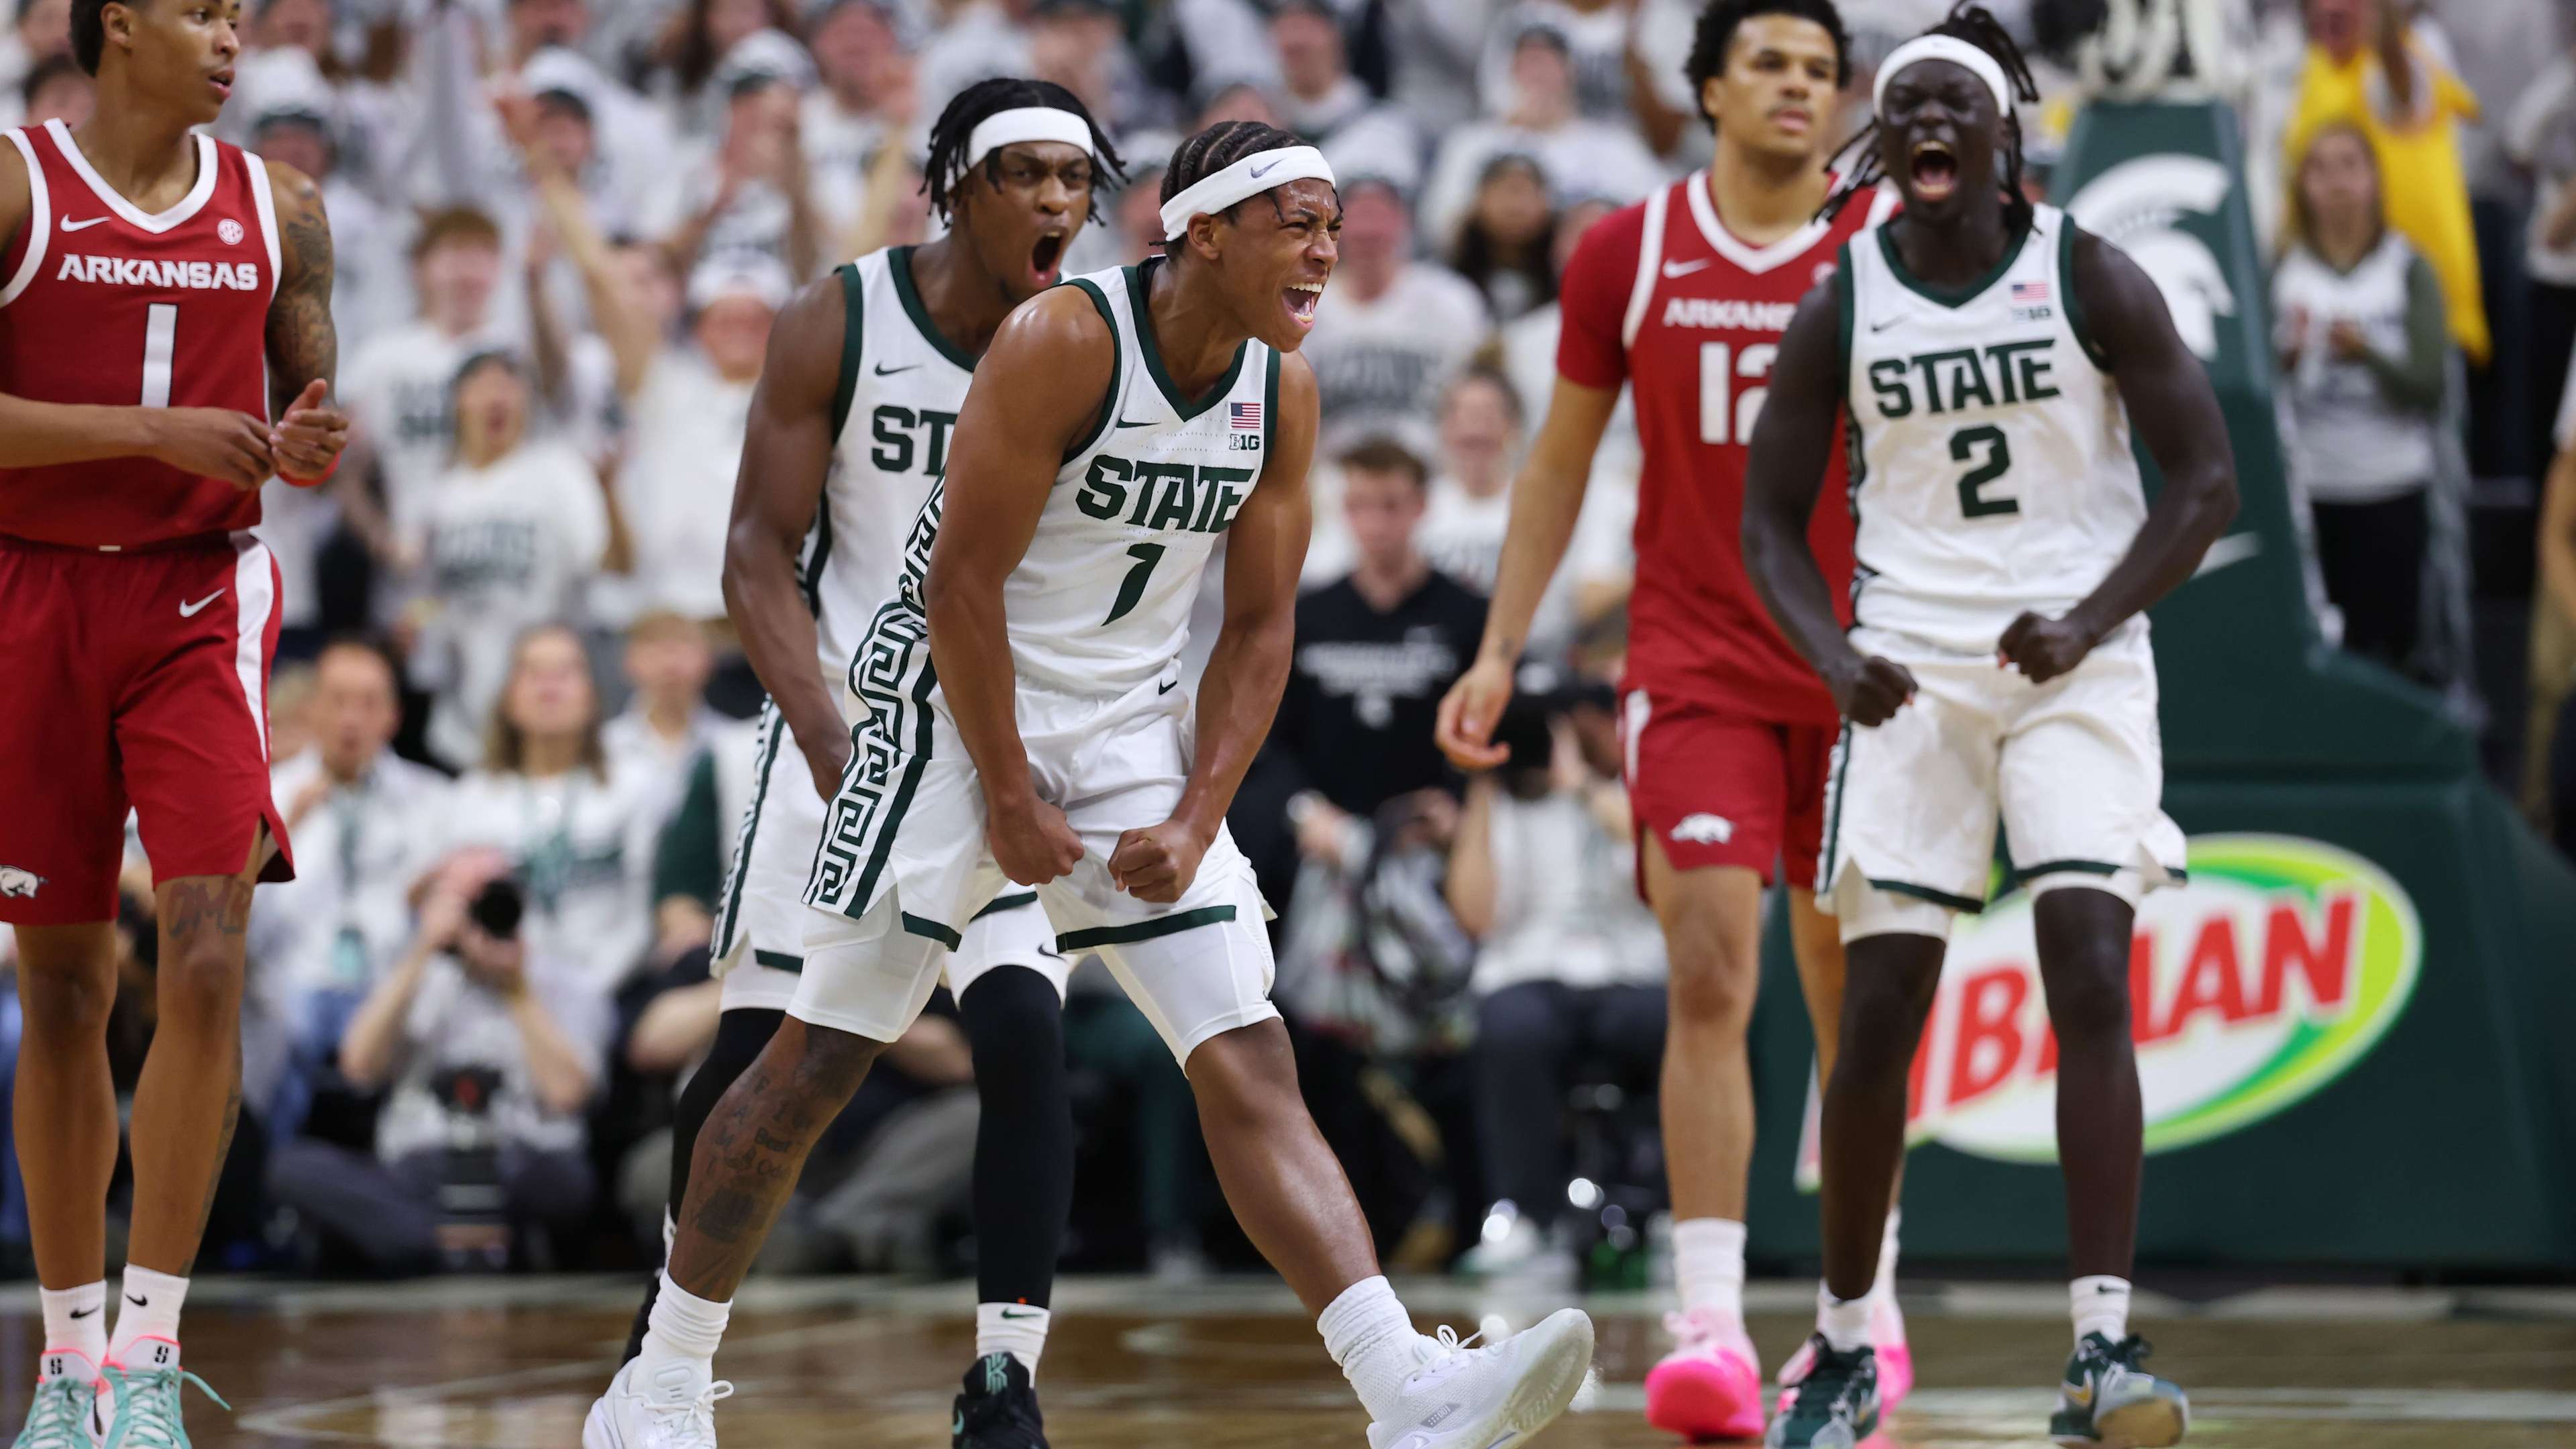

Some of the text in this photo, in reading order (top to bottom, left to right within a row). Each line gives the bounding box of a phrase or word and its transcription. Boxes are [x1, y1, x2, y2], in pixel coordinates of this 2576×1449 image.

[56, 253, 259, 290] ARKANSAS
[141, 303, 178, 408] 1
[1699, 341, 1779, 445] 12
[1869, 339, 2061, 418] STATE
[1075, 454, 1255, 533] STATE
[1949, 425, 2019, 518] 2
[1101, 542, 1166, 627] 1
